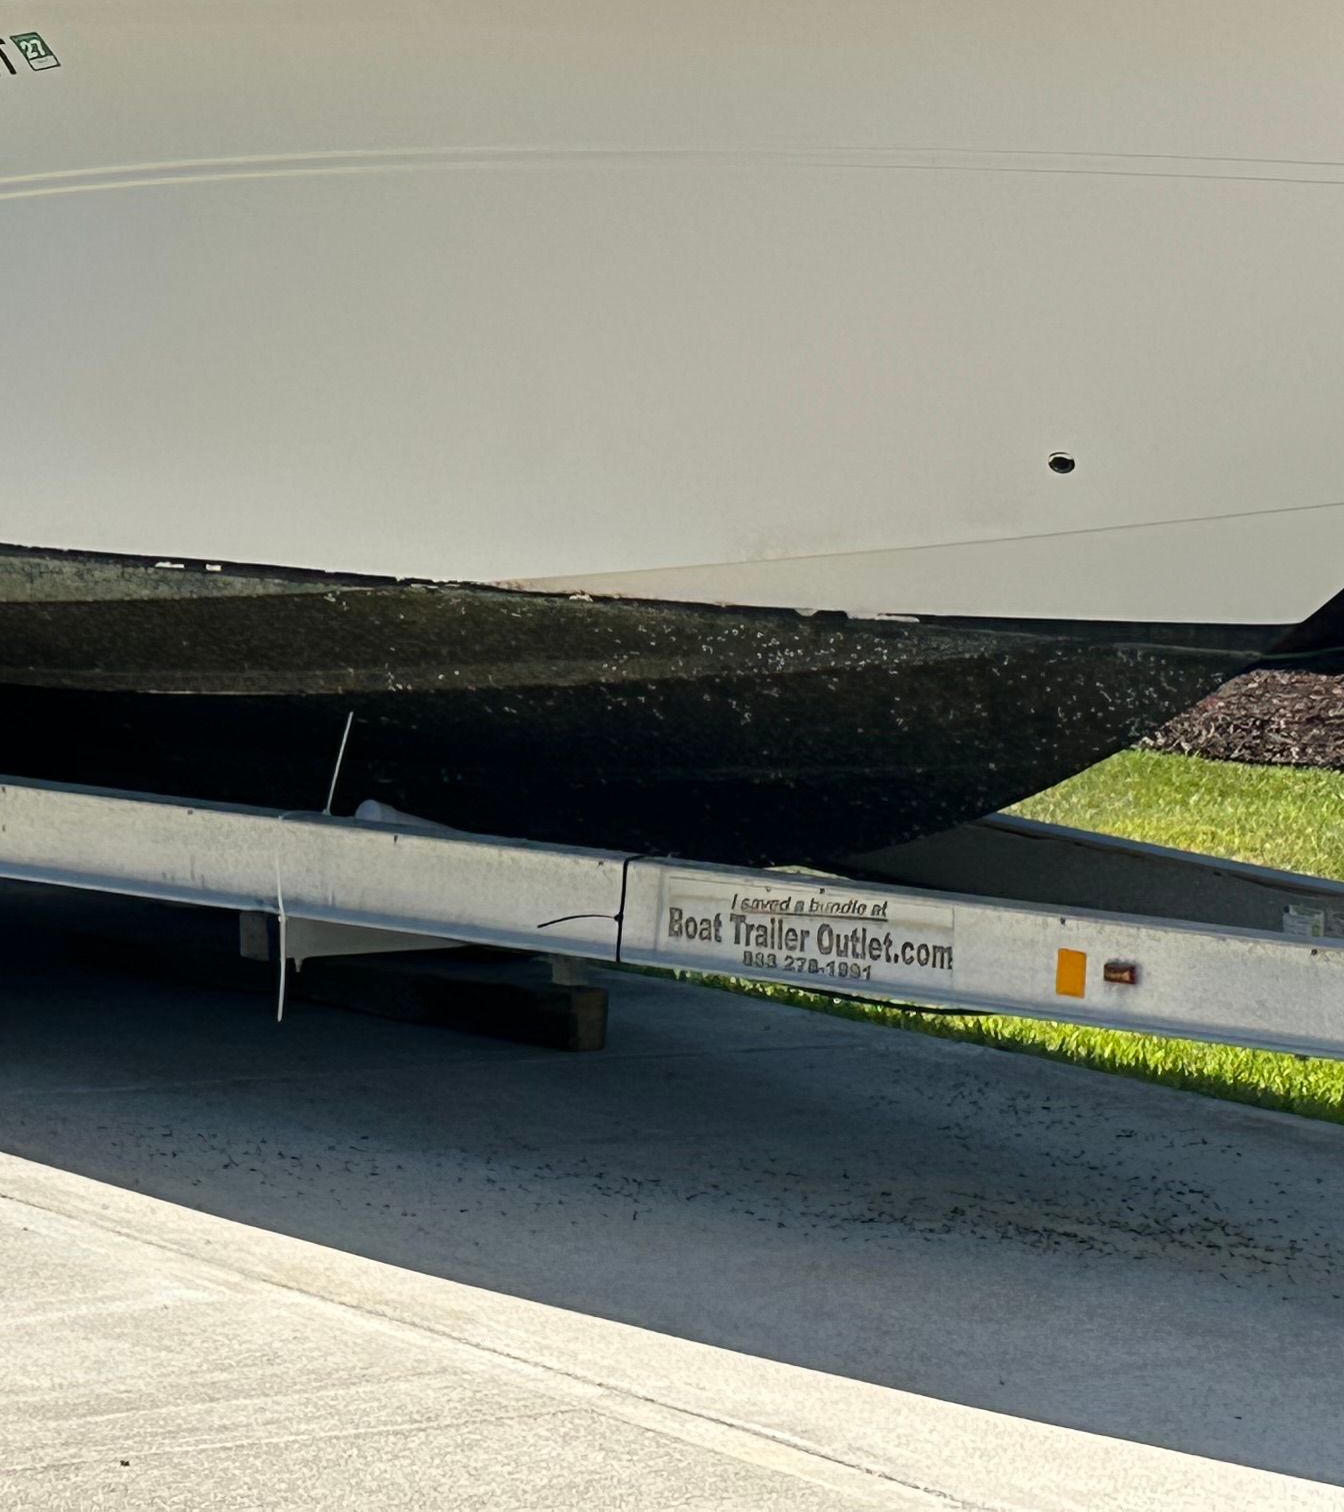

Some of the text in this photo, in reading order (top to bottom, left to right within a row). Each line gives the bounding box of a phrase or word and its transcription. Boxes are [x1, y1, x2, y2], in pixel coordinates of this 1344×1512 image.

[730, 892, 739, 910] I
[809, 897, 868, 916] bundle
[667, 906, 954, 971] Boat Trailer Outlet.com
